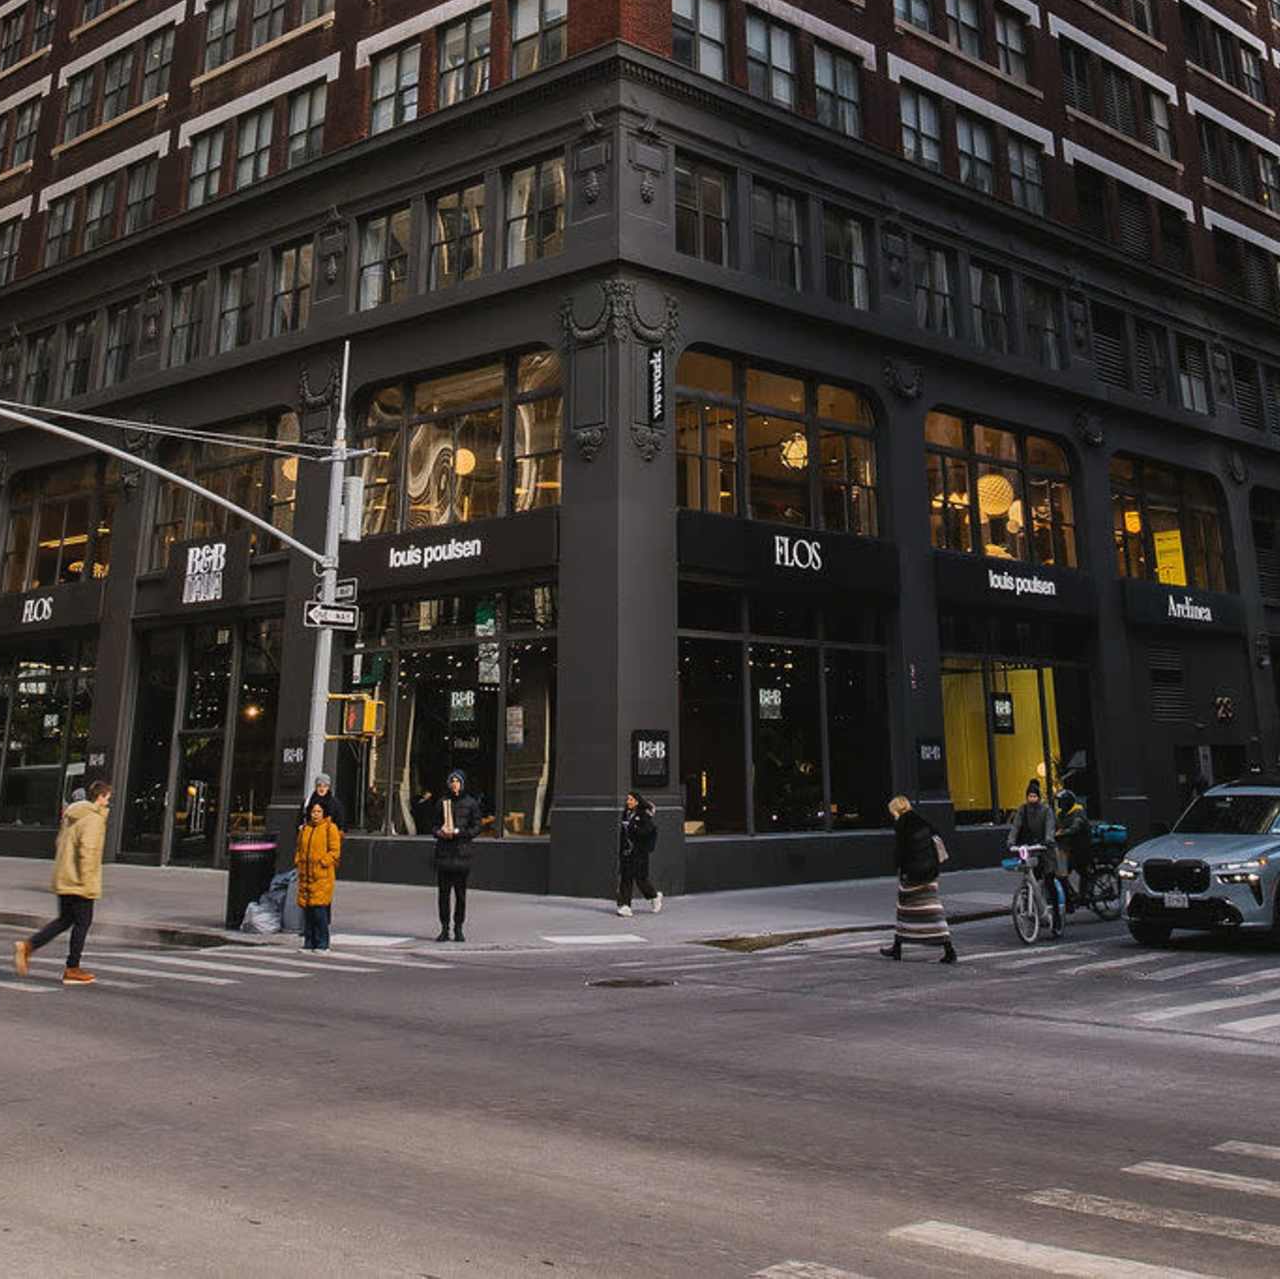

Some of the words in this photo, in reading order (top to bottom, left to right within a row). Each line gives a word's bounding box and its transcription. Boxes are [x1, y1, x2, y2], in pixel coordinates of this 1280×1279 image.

[649, 350, 662, 419] wework
[187, 543, 227, 574] B&B
[389, 544, 422, 568] louis
[423, 538, 481, 569] poulsen
[775, 535, 822, 570] FLOS
[988, 569, 1014, 590] louis
[1015, 576, 1056, 596] poulsen
[1168, 595, 1213, 621] Arclinea
[451, 691, 475, 707] B&B
[639, 740, 666, 759] B&B
